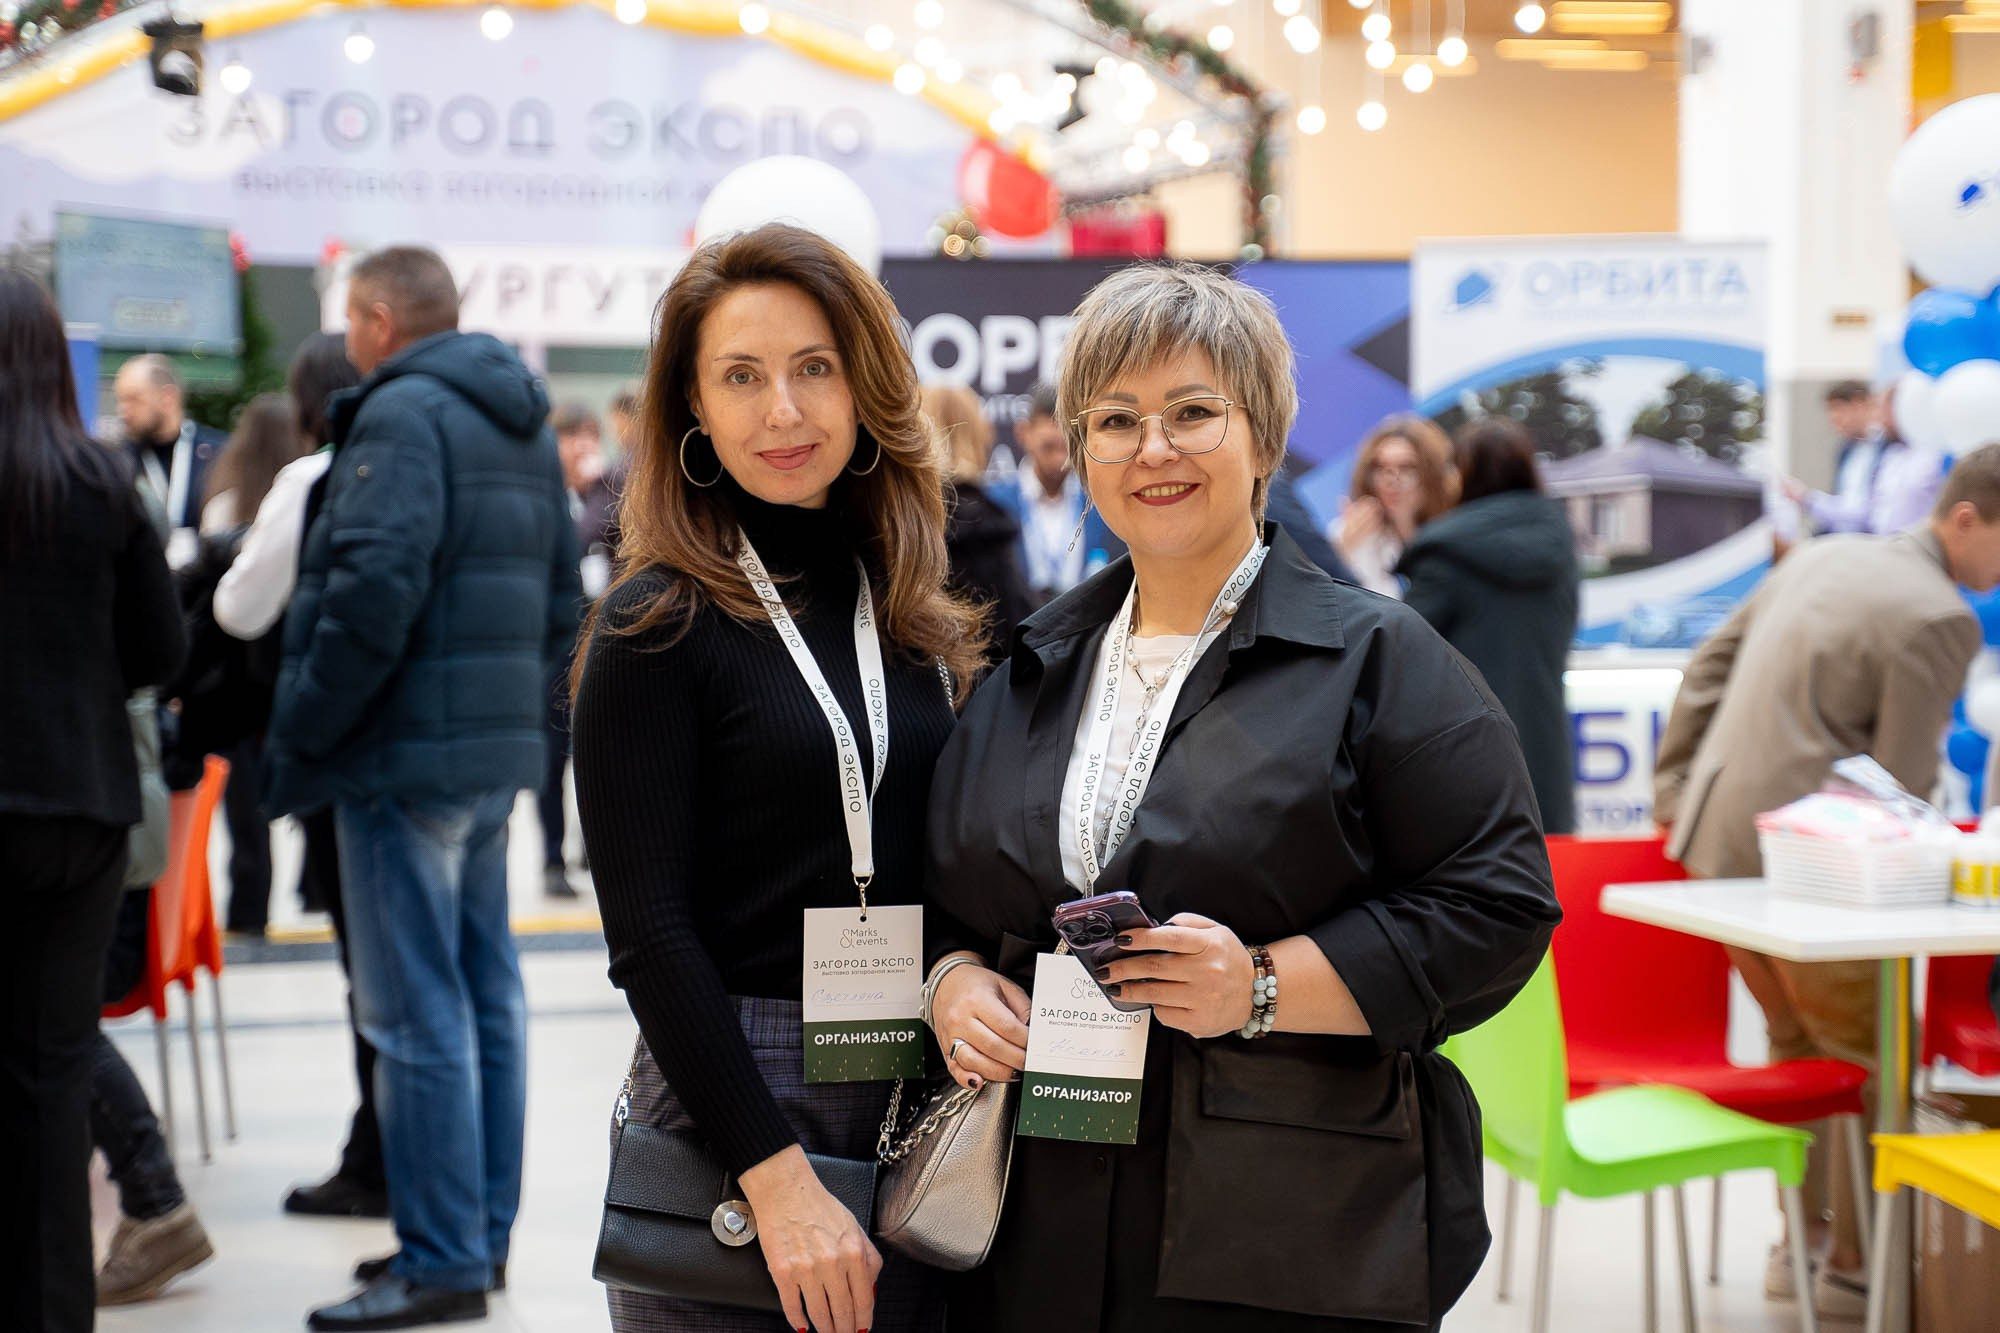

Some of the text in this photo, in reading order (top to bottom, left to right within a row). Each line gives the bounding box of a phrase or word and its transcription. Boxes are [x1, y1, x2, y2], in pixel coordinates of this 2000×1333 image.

[168, 89, 876, 166] ЗАГОРОД ЭКСПО
[457, 262, 674, 316] УРГУТ
[1522, 258, 1751, 302] ОРБИТА
[869, 678, 884, 728] ЭКСПО
[1100, 676, 1118, 721] ЭКСПО
[814, 683, 861, 813] ЗАГОРОД ЭКСПО
[1111, 720, 1161, 851] ЗАГОРОД ЭКСПО
[1080, 753, 1100, 874] ЗАГОРОД ЭКСПО
[851, 928, 878, 937] Marks
[856, 937, 888, 946] events
[813, 957, 915, 969] ЗАГОРОД ЭКСПО
[814, 1030, 916, 1046] ОРГАНИЗАТОР
[1040, 1008, 1142, 1024] ЗАГОРОД ЭКСПО
[1032, 1084, 1132, 1104] ОРГАНИЗАТОР
